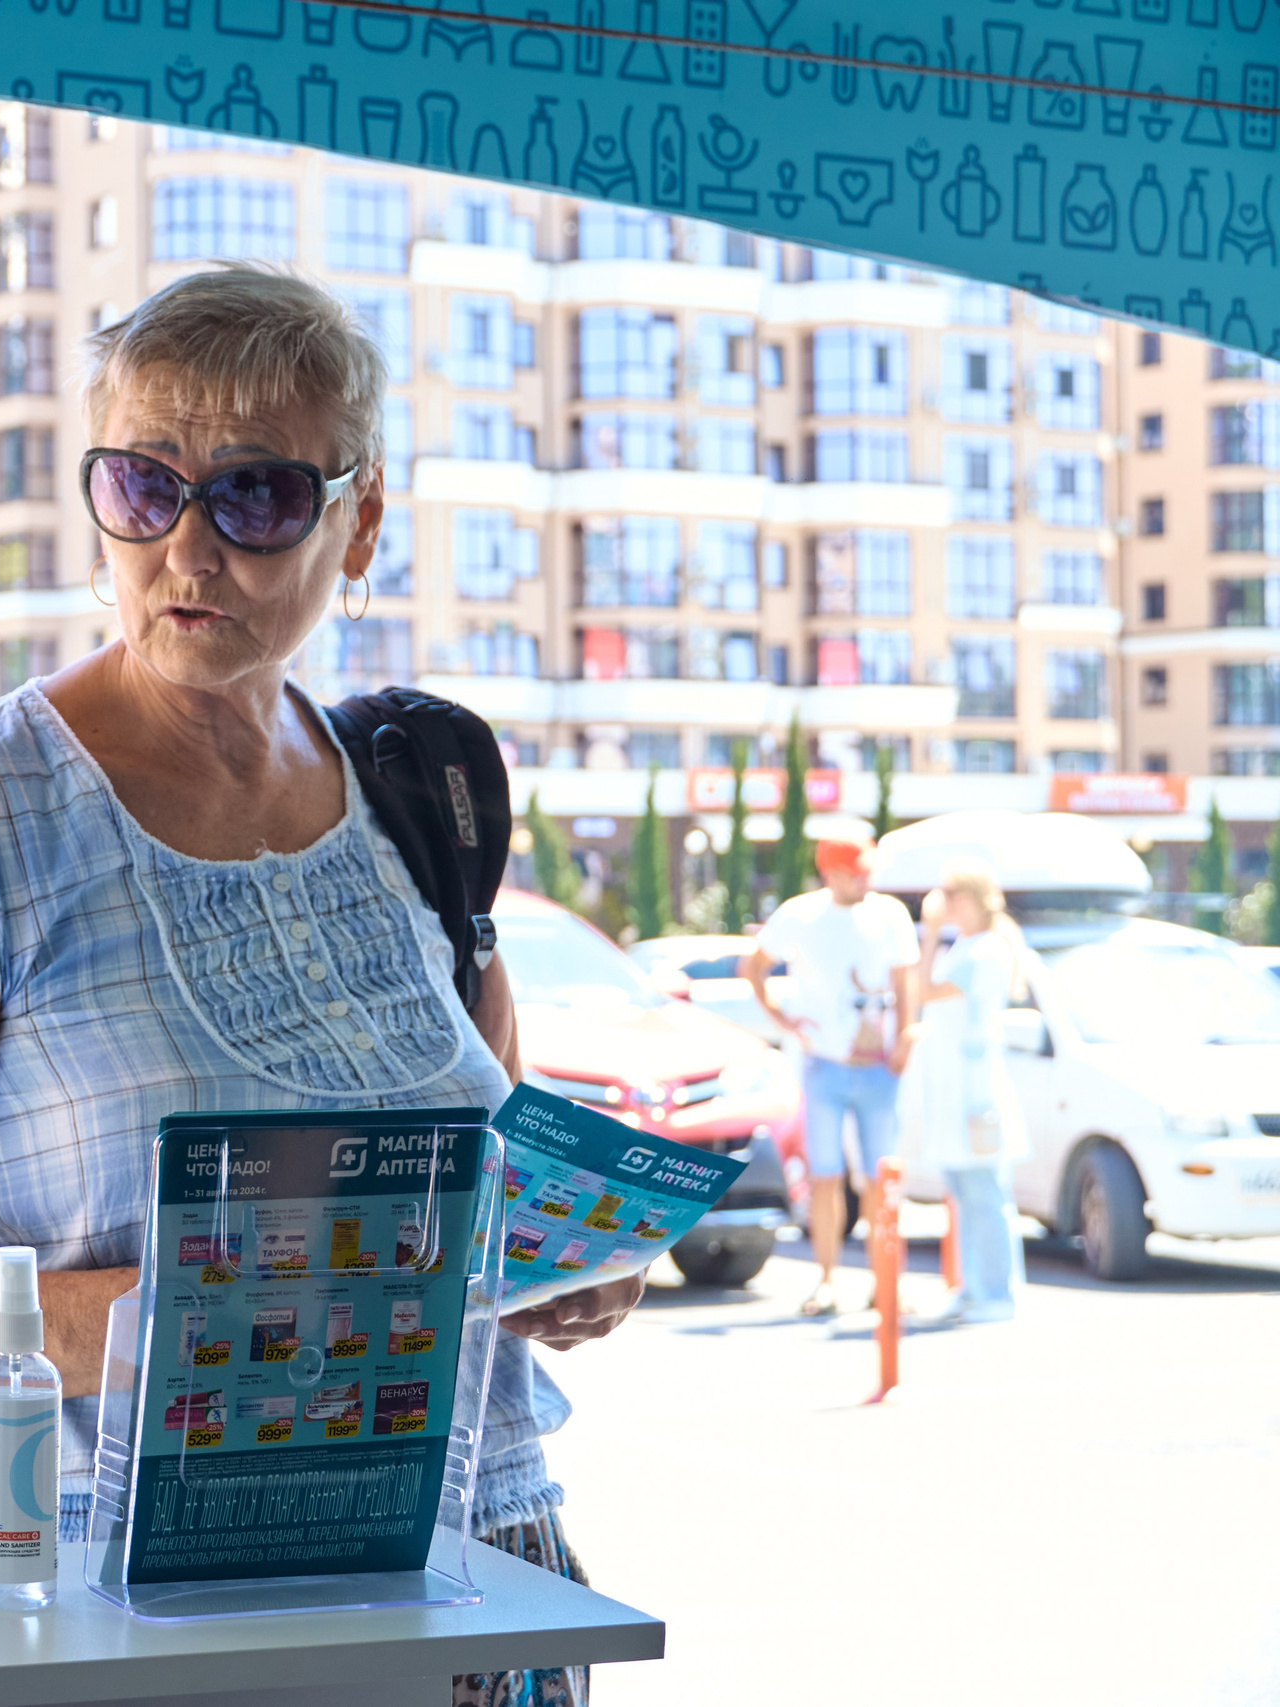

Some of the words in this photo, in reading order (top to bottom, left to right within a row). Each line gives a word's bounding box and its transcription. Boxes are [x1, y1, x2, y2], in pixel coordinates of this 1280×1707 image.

[450, 772, 474, 842] PULSAR
[521, 1102, 554, 1123] ЦЕНА
[515, 1113, 540, 1130] ЧТО
[540, 1124, 580, 1146] НАДО!
[377, 1133, 459, 1153] МАГНИТ
[186, 1162, 218, 1177] ЧТО
[660, 1155, 723, 1180] МАГНИТ
[650, 1170, 711, 1193] АПТЕКА
[206, 1188, 238, 1198] авта
[240, 1186, 261, 1195] 2024
[262, 1247, 301, 1258] ТАУФОН
[360, 1253, 376, 1261] -20%
[283, 1338, 300, 1347] -20%
[351, 1334, 368, 1342] -20%
[214, 1342, 230, 1350] -25%
[380, 1386, 426, 1398] ВЕНАРУС
[410, 1408, 426, 1416] -20%
[207, 1423, 223, 1431] -25%
[275, 1419, 292, 1427] -20%
[199, 1475, 261, 1528] ЯВЛЯЕТСЯ
[356, 1462, 423, 1521] СРЕДСТВОМ
[146, 1535, 197, 1551] ИМЕЮТСЯ
[198, 1528, 305, 1549] ПРОТИВОПОКАЗАНИЯ.
[307, 1525, 339, 1545] ПЕРЕД
[340, 1519, 415, 1539] ПРИМЕНЕНИЕМ
[141, 1548, 264, 1569] ПРОКОНСУЛЬТИРУЙТЕСЬ
[267, 1546, 282, 1561] СО
[283, 1541, 365, 1560] СПЕЦИАЛИСТОМ
